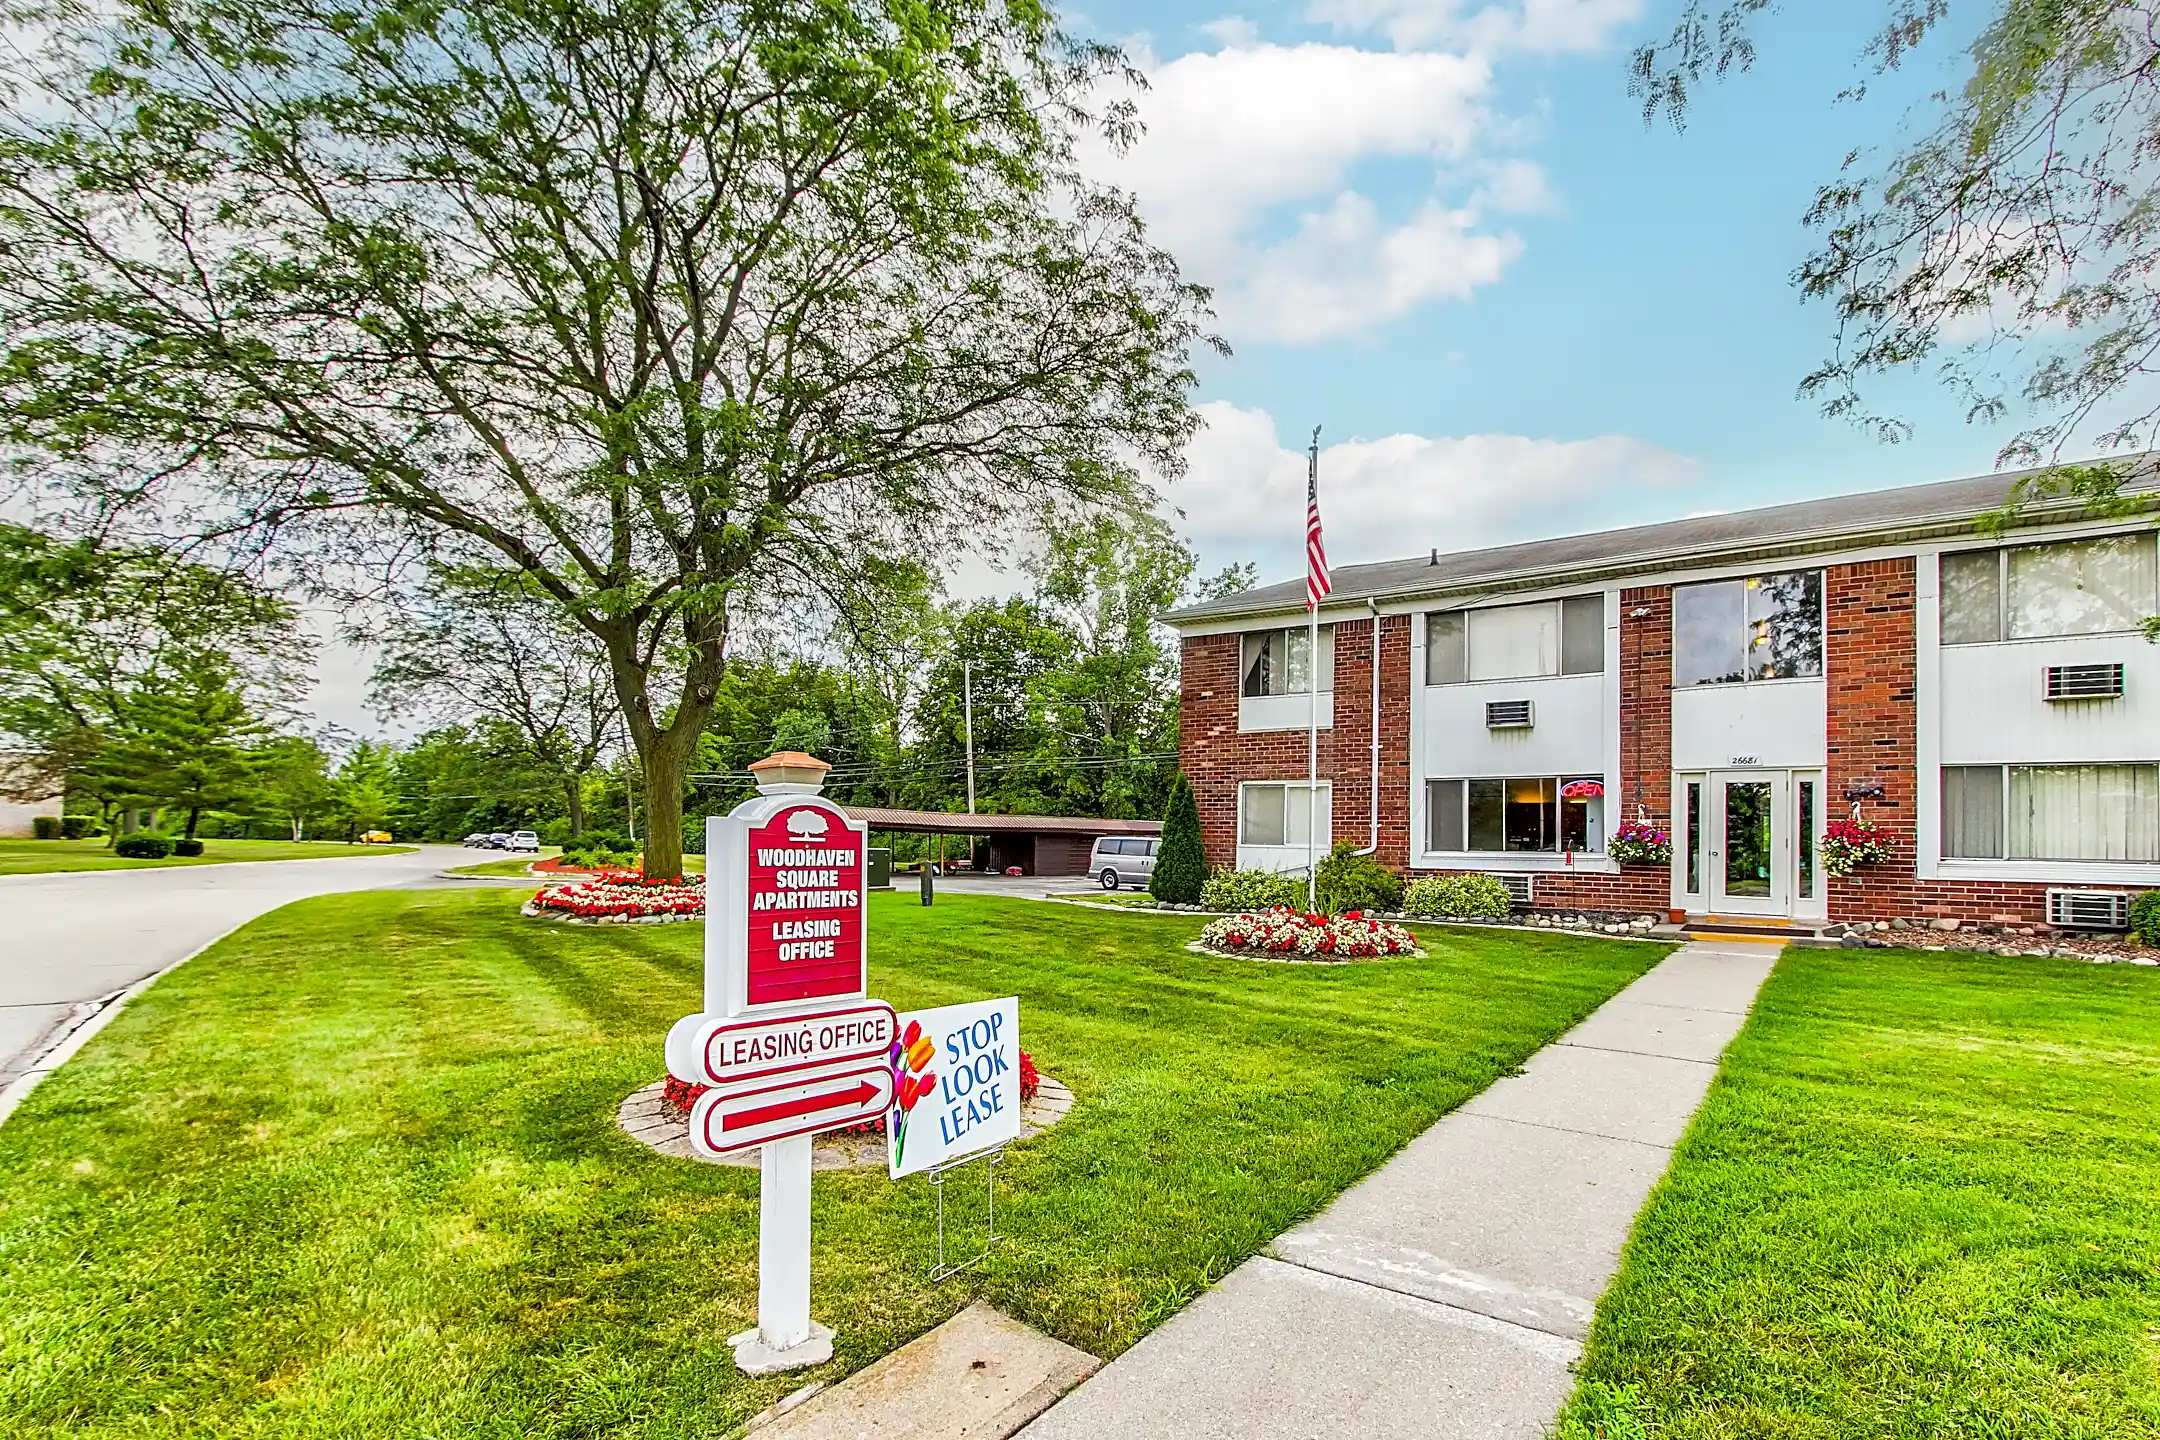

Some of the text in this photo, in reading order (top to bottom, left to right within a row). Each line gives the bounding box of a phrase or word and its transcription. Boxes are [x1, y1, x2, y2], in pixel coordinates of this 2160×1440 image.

[1731, 756, 1758, 765] 26681
[1563, 783, 1604, 797] OPEN
[757, 848, 855, 867] WOODHAVEN
[776, 869, 839, 890] SQUARE
[753, 889, 858, 911] APARTMENTS
[772, 919, 841, 940] LEASING
[778, 940, 835, 961] OFFICE
[719, 1018, 886, 1067] LEASING OFFICE
[945, 1012, 1003, 1065] STOP
[941, 1044, 1009, 1105] LOOK
[940, 1083, 1004, 1146] LEASE
